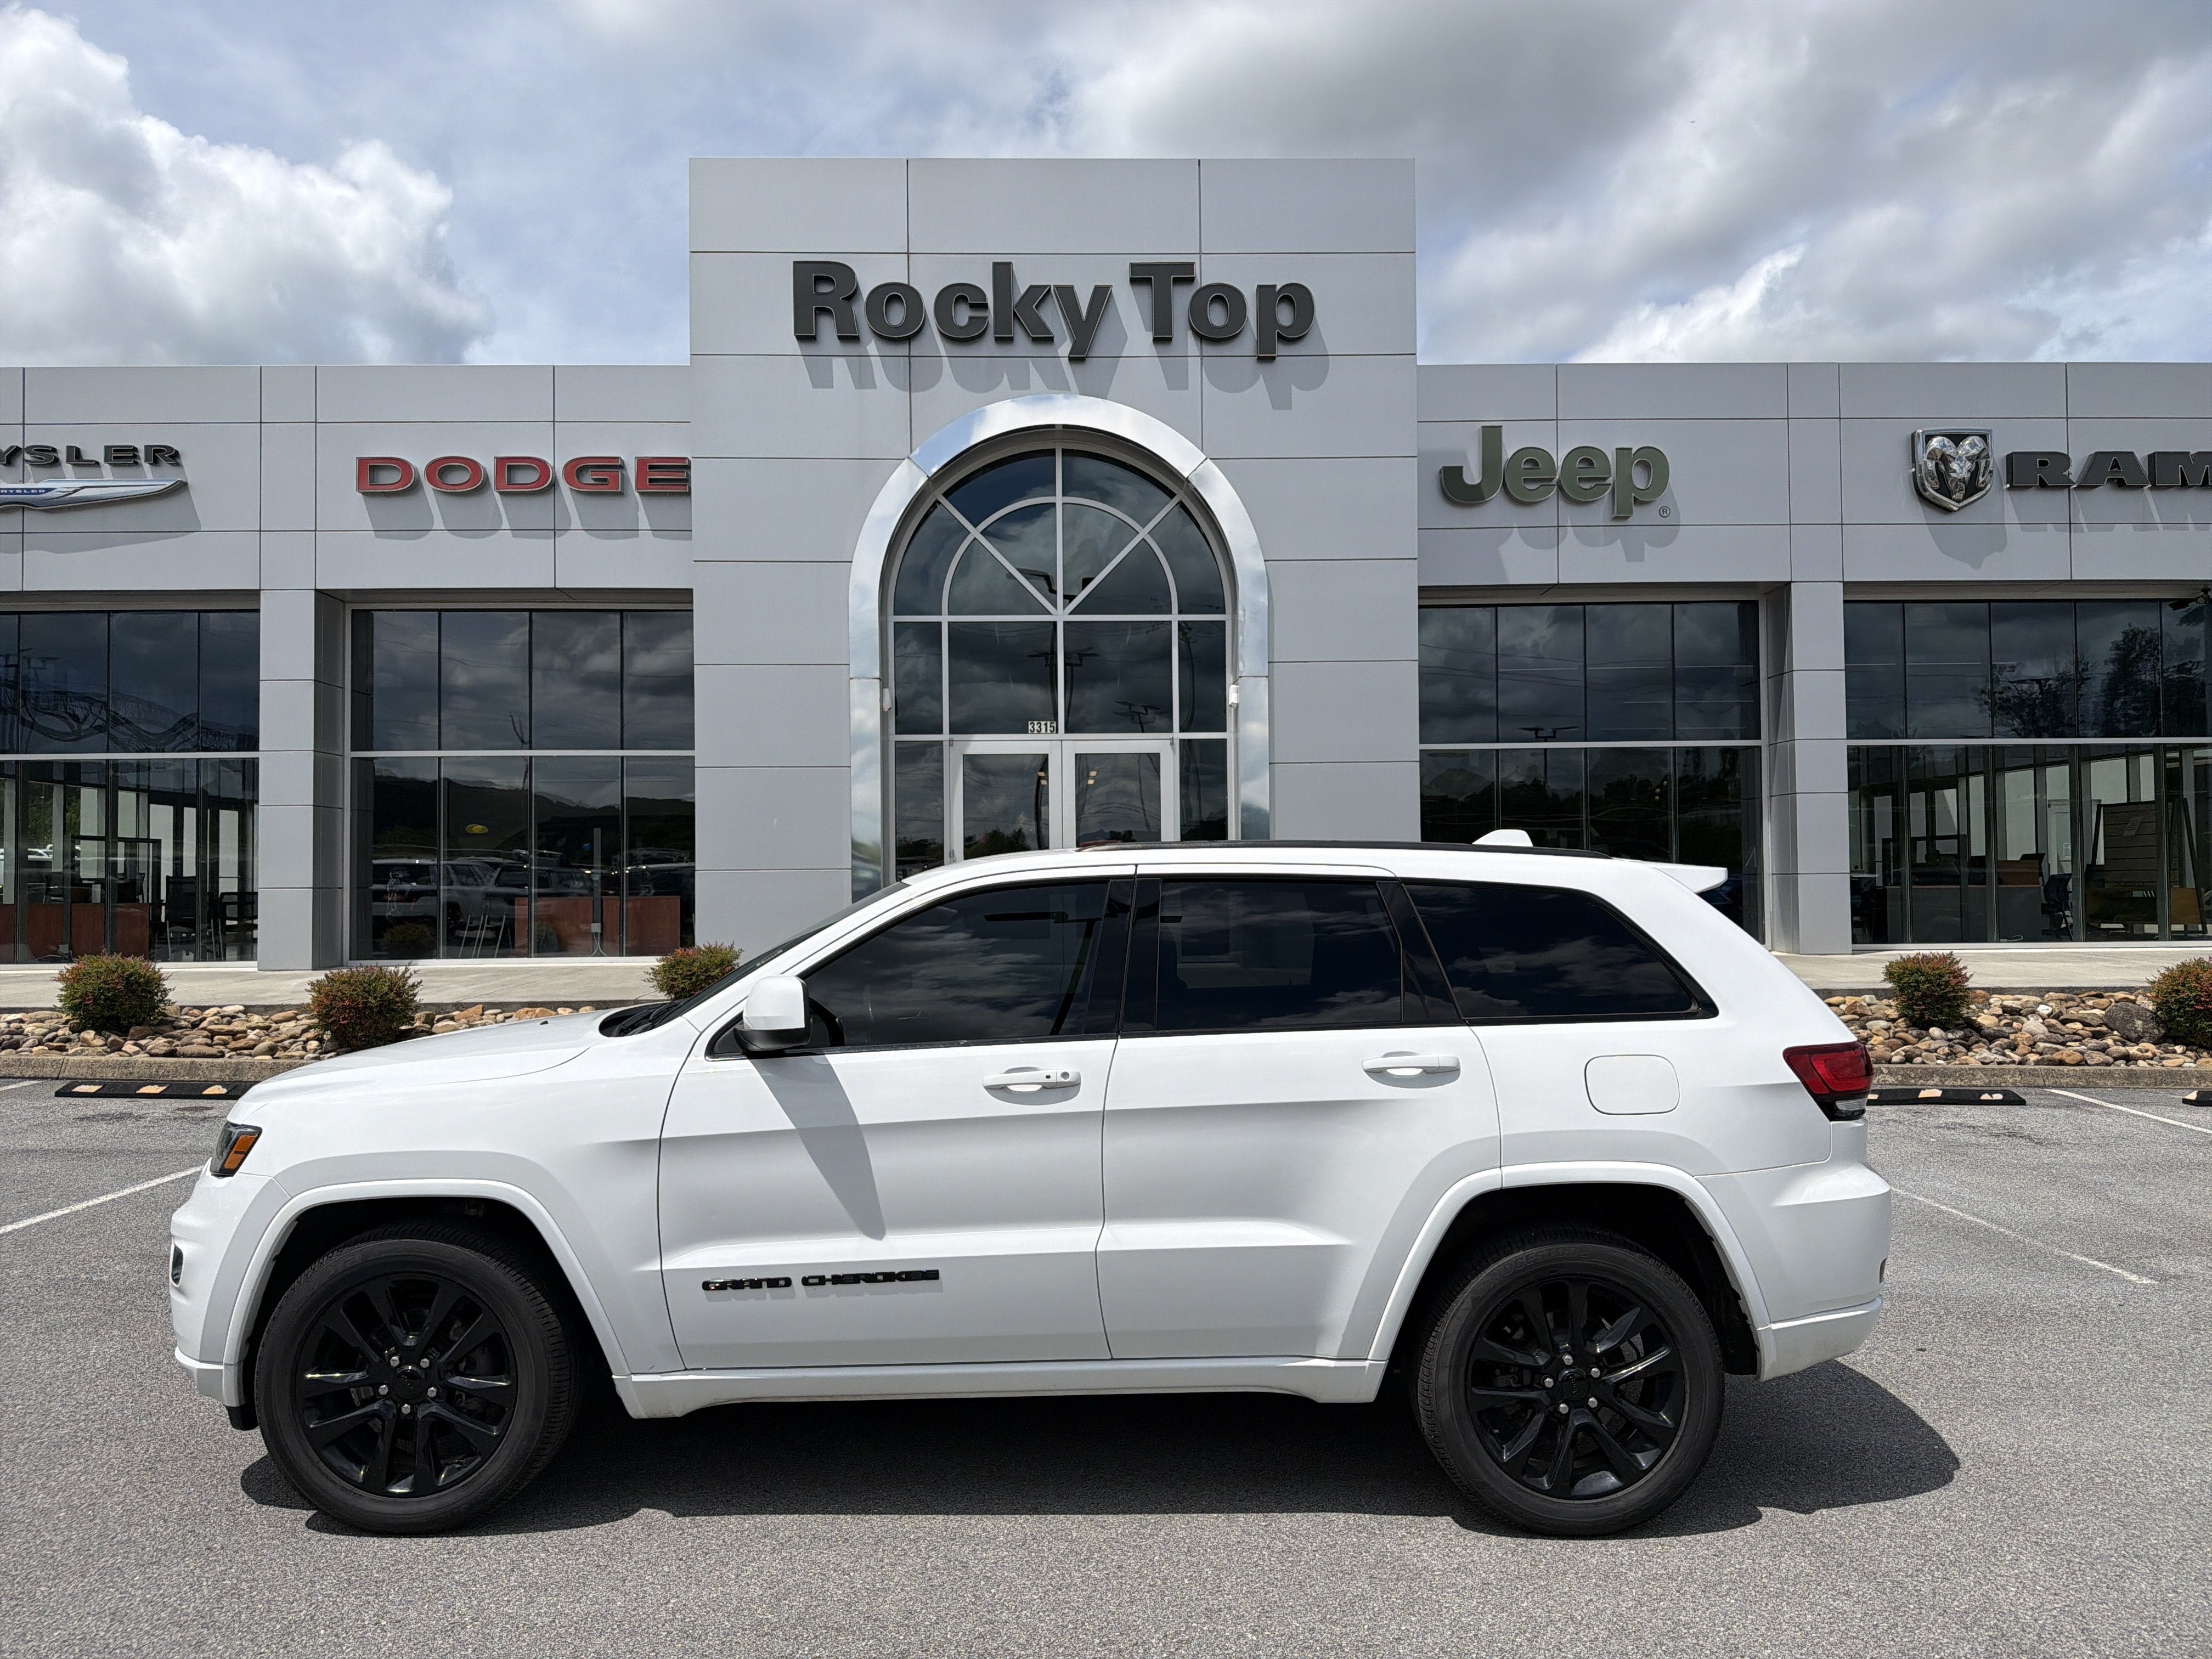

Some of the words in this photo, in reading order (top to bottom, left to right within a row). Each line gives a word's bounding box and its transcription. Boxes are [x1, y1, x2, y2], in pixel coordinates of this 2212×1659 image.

[792, 261, 1113, 360] Rocky
[1129, 262, 1316, 360] Top
[356, 456, 691, 493] DODGE
[1440, 425, 1670, 518] Jeep
[2006, 452, 2212, 488] RAM
[1029, 721, 1055, 733] 3315
[702, 1277, 792, 1290] GRAND
[802, 1269, 939, 1286] CHEROKEE
